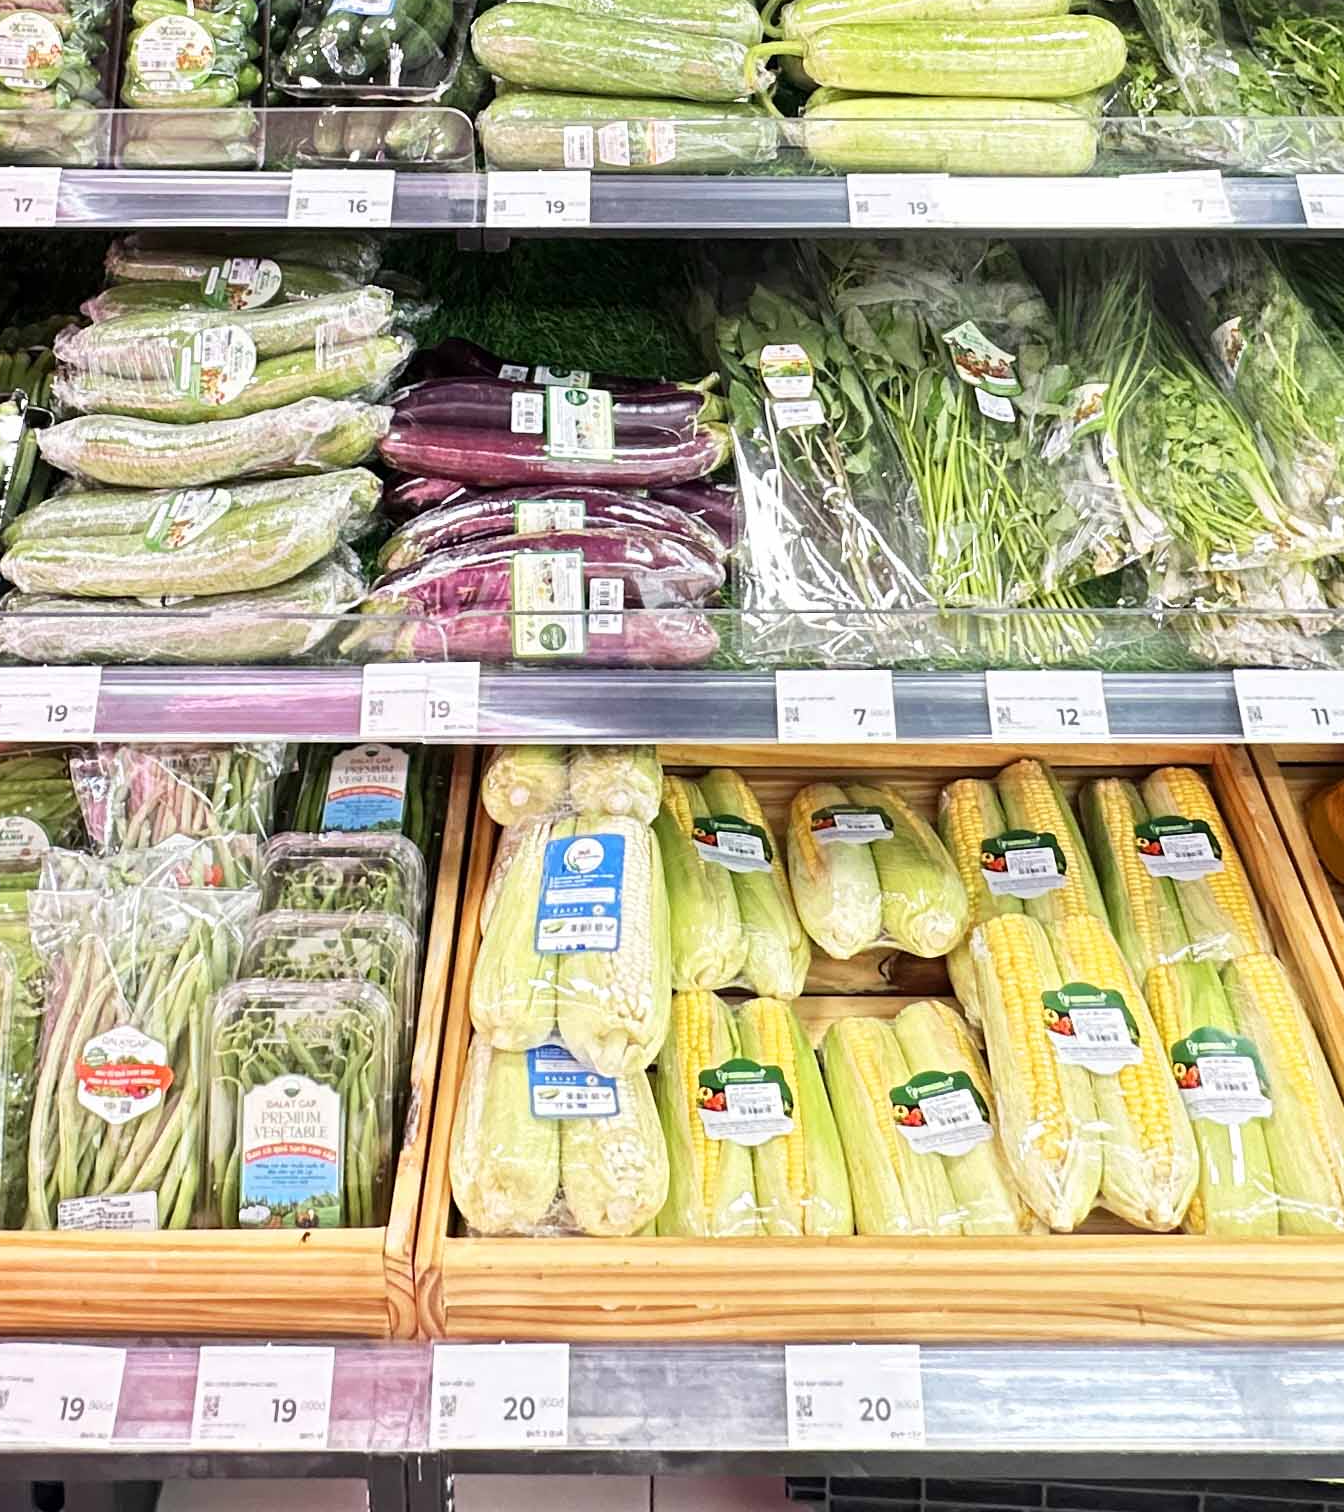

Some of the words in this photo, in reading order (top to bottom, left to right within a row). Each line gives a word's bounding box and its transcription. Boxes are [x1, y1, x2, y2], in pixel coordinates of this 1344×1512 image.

[13, 197, 34, 213] 17
[348, 199, 368, 214] 16
[545, 200, 566, 214] 19
[907, 201, 929, 216] 19
[47, 704, 69, 723] 19
[428, 700, 451, 719] 19
[853, 708, 867, 726] 7
[1056, 708, 1081, 726] 12
[1311, 707, 1330, 726] 11
[261, 1111, 321, 1125] PREMIUM
[254, 1125, 328, 1140] VEGETABLE
[60, 1396, 85, 1422] 19
[271, 1398, 297, 1423] 19
[503, 1396, 536, 1421] 20
[858, 1397, 892, 1422] 20
